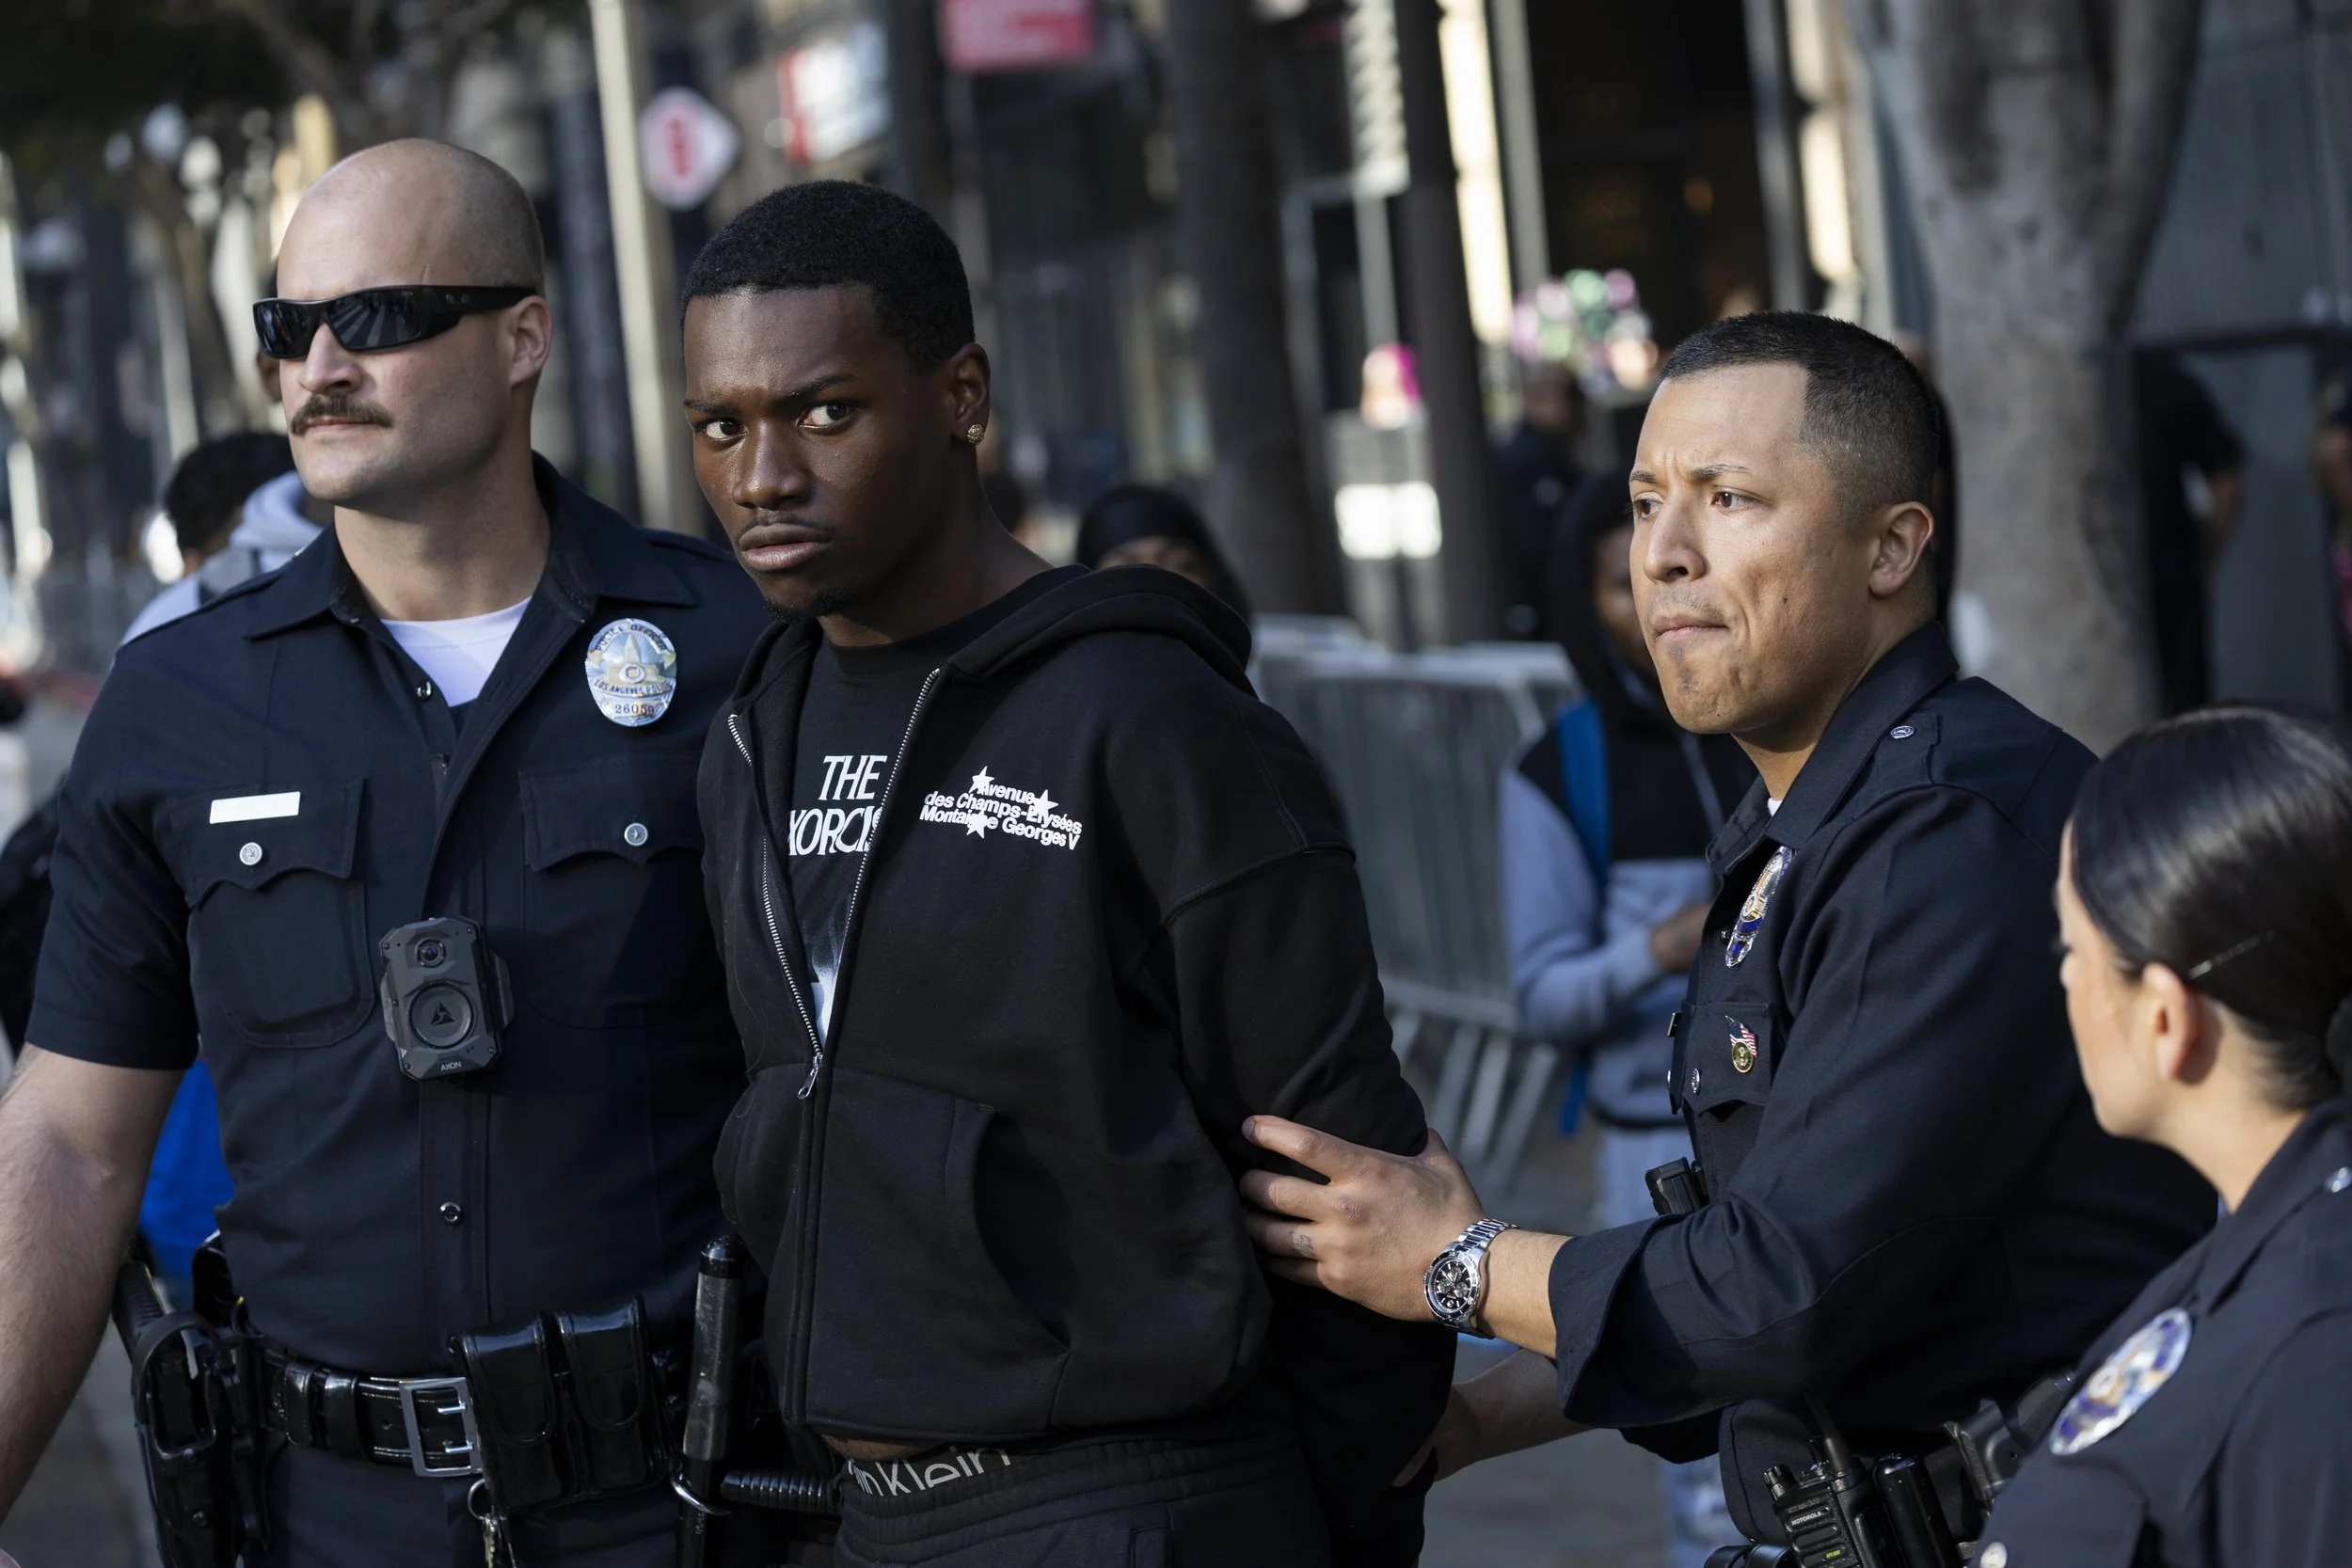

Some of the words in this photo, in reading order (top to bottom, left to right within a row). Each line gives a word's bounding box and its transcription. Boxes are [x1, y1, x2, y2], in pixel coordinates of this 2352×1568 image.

[595, 678, 608, 691] LOS
[818, 755, 888, 800] THE
[924, 790, 955, 808] des
[977, 783, 1036, 805] Avenue
[919, 804, 999, 830] Montaie
[1002, 816, 1068, 847] Georges
[1068, 832, 1081, 850] V
[440, 1061, 462, 1071] AXON
[875, 1446, 1011, 1497] klein
[1791, 1511, 1822, 1526] MOTOROLA
